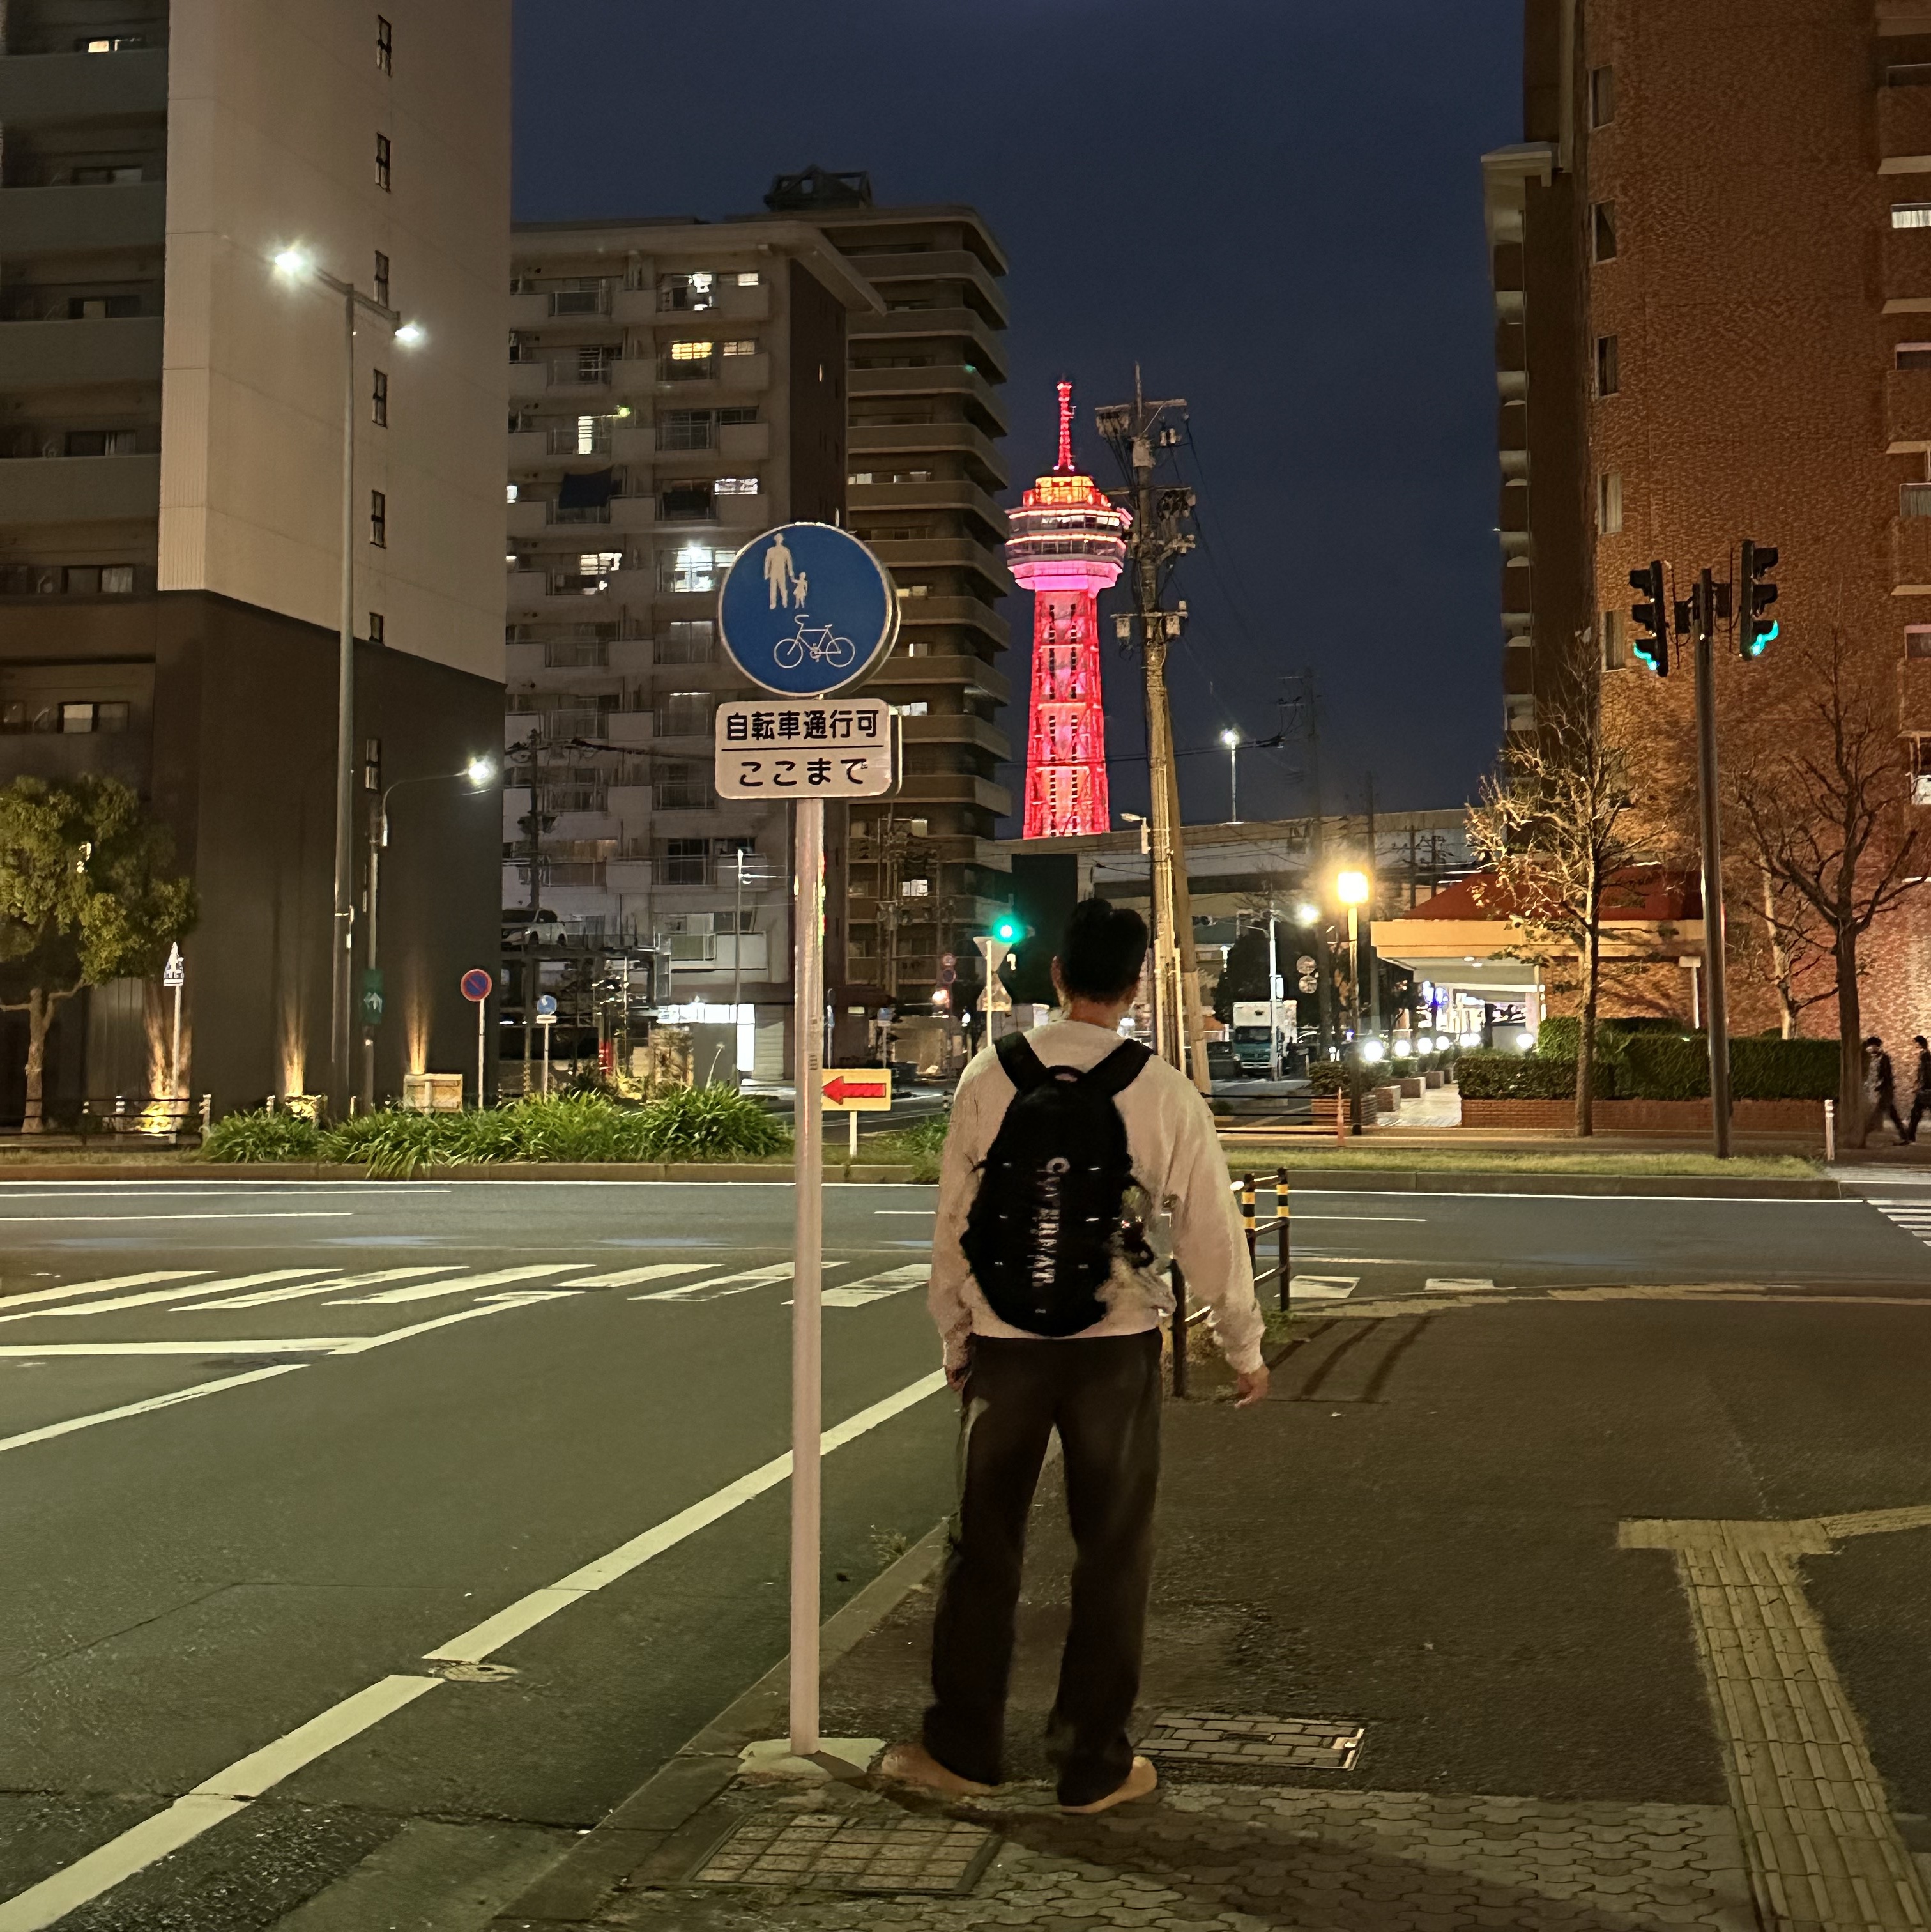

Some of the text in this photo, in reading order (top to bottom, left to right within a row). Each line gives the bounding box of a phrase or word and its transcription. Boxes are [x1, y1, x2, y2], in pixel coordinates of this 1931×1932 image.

[726, 709, 879, 741] 自転車通行可
[739, 757, 868, 787] ここまで
